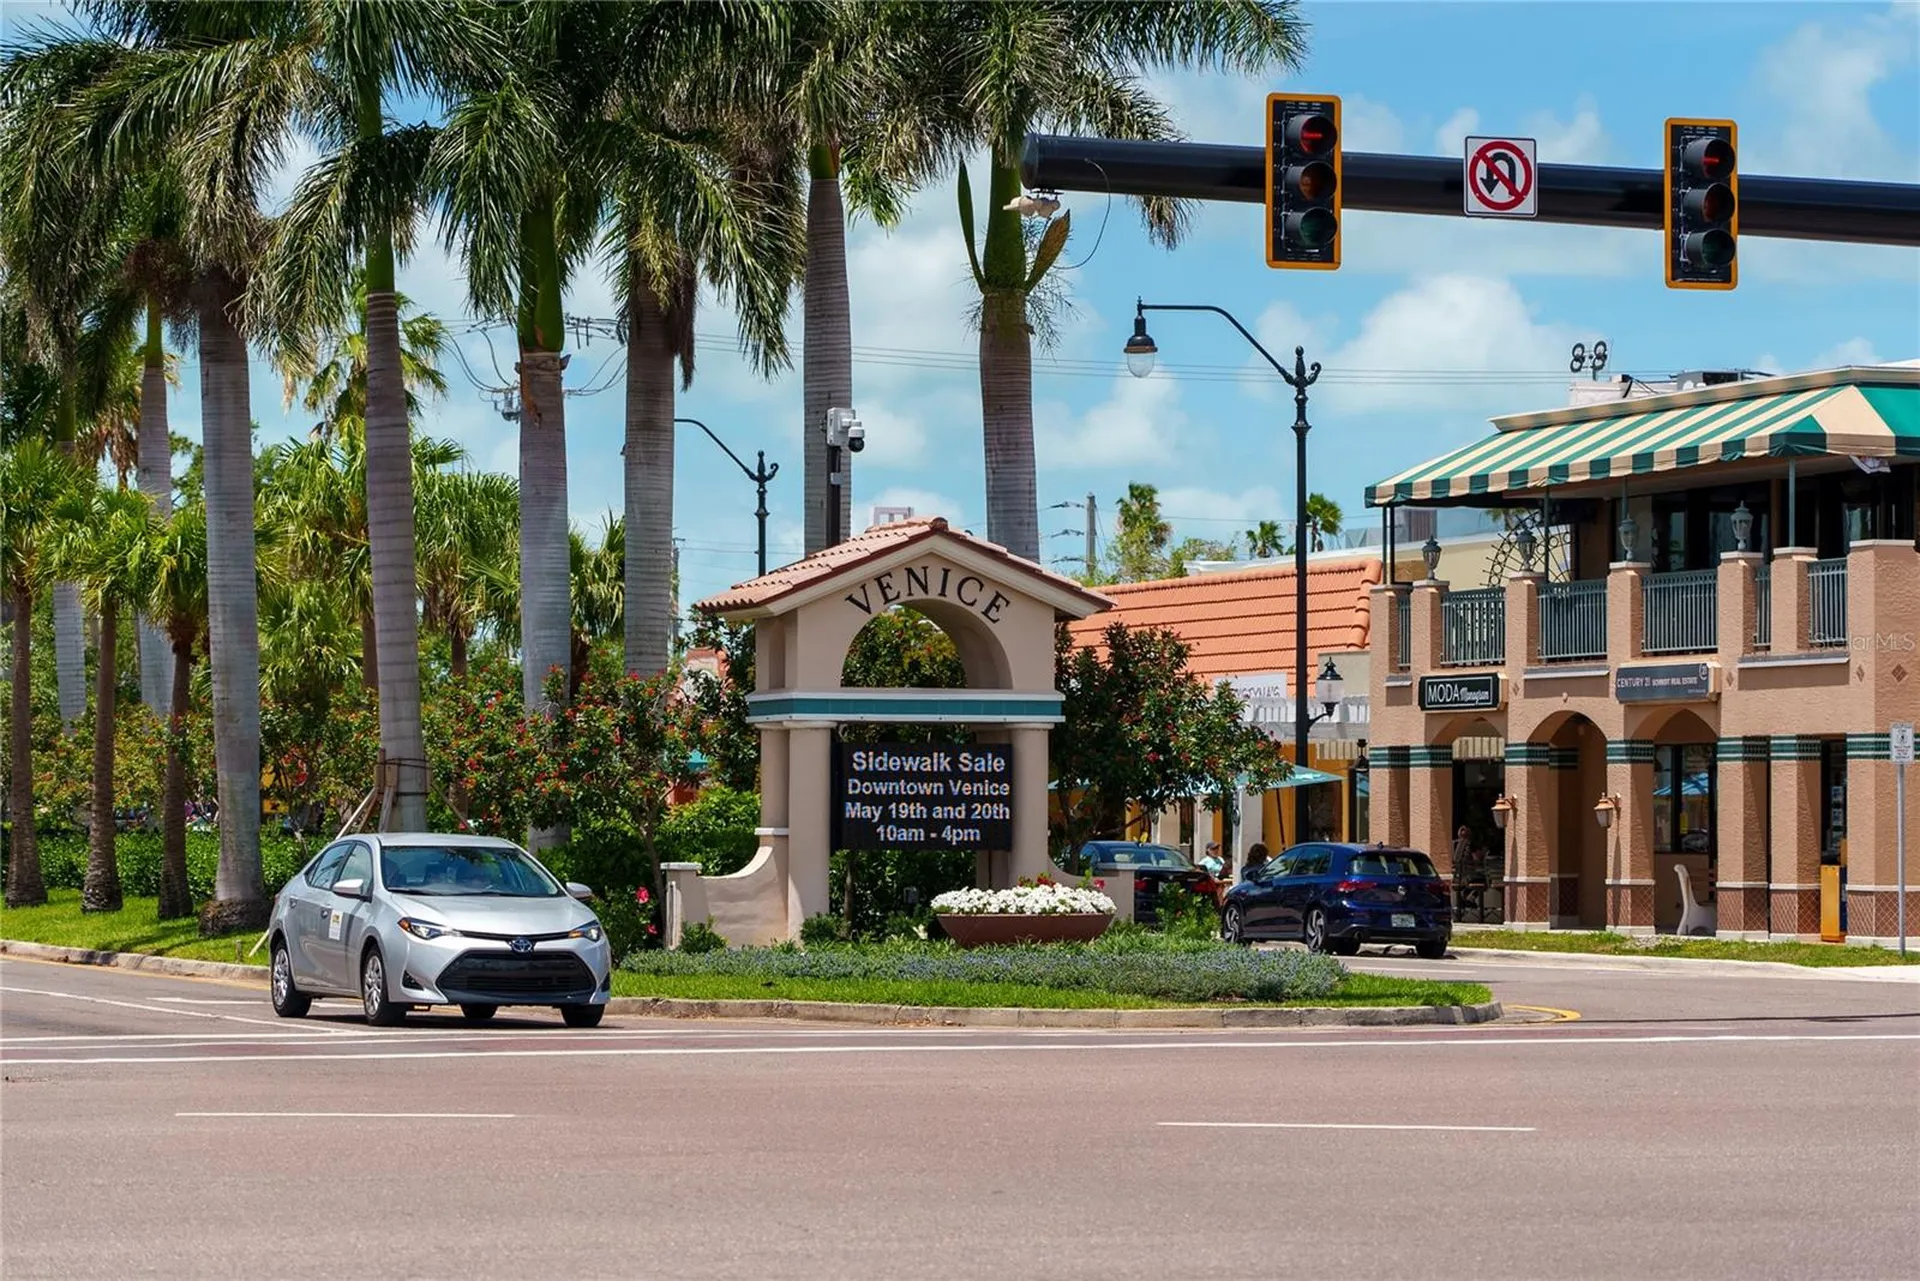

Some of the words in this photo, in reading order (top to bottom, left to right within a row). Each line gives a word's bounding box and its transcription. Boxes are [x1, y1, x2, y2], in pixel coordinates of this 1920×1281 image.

[845, 566, 1011, 624] VENICE
[1617, 677, 1644, 688] CENTURY
[1682, 676, 1698, 685] ESTATE
[1428, 683, 1459, 702] MODA
[852, 751, 952, 772] Sidewalk
[958, 751, 1006, 773] Sale
[847, 778, 944, 795] Downtown
[949, 779, 1010, 796] Venice
[844, 802, 883, 822] May
[888, 802, 927, 819] 19th
[932, 803, 966, 819] and
[971, 803, 1011, 820] 20th
[876, 825, 925, 841] 10am
[941, 825, 981, 845] 4pm
